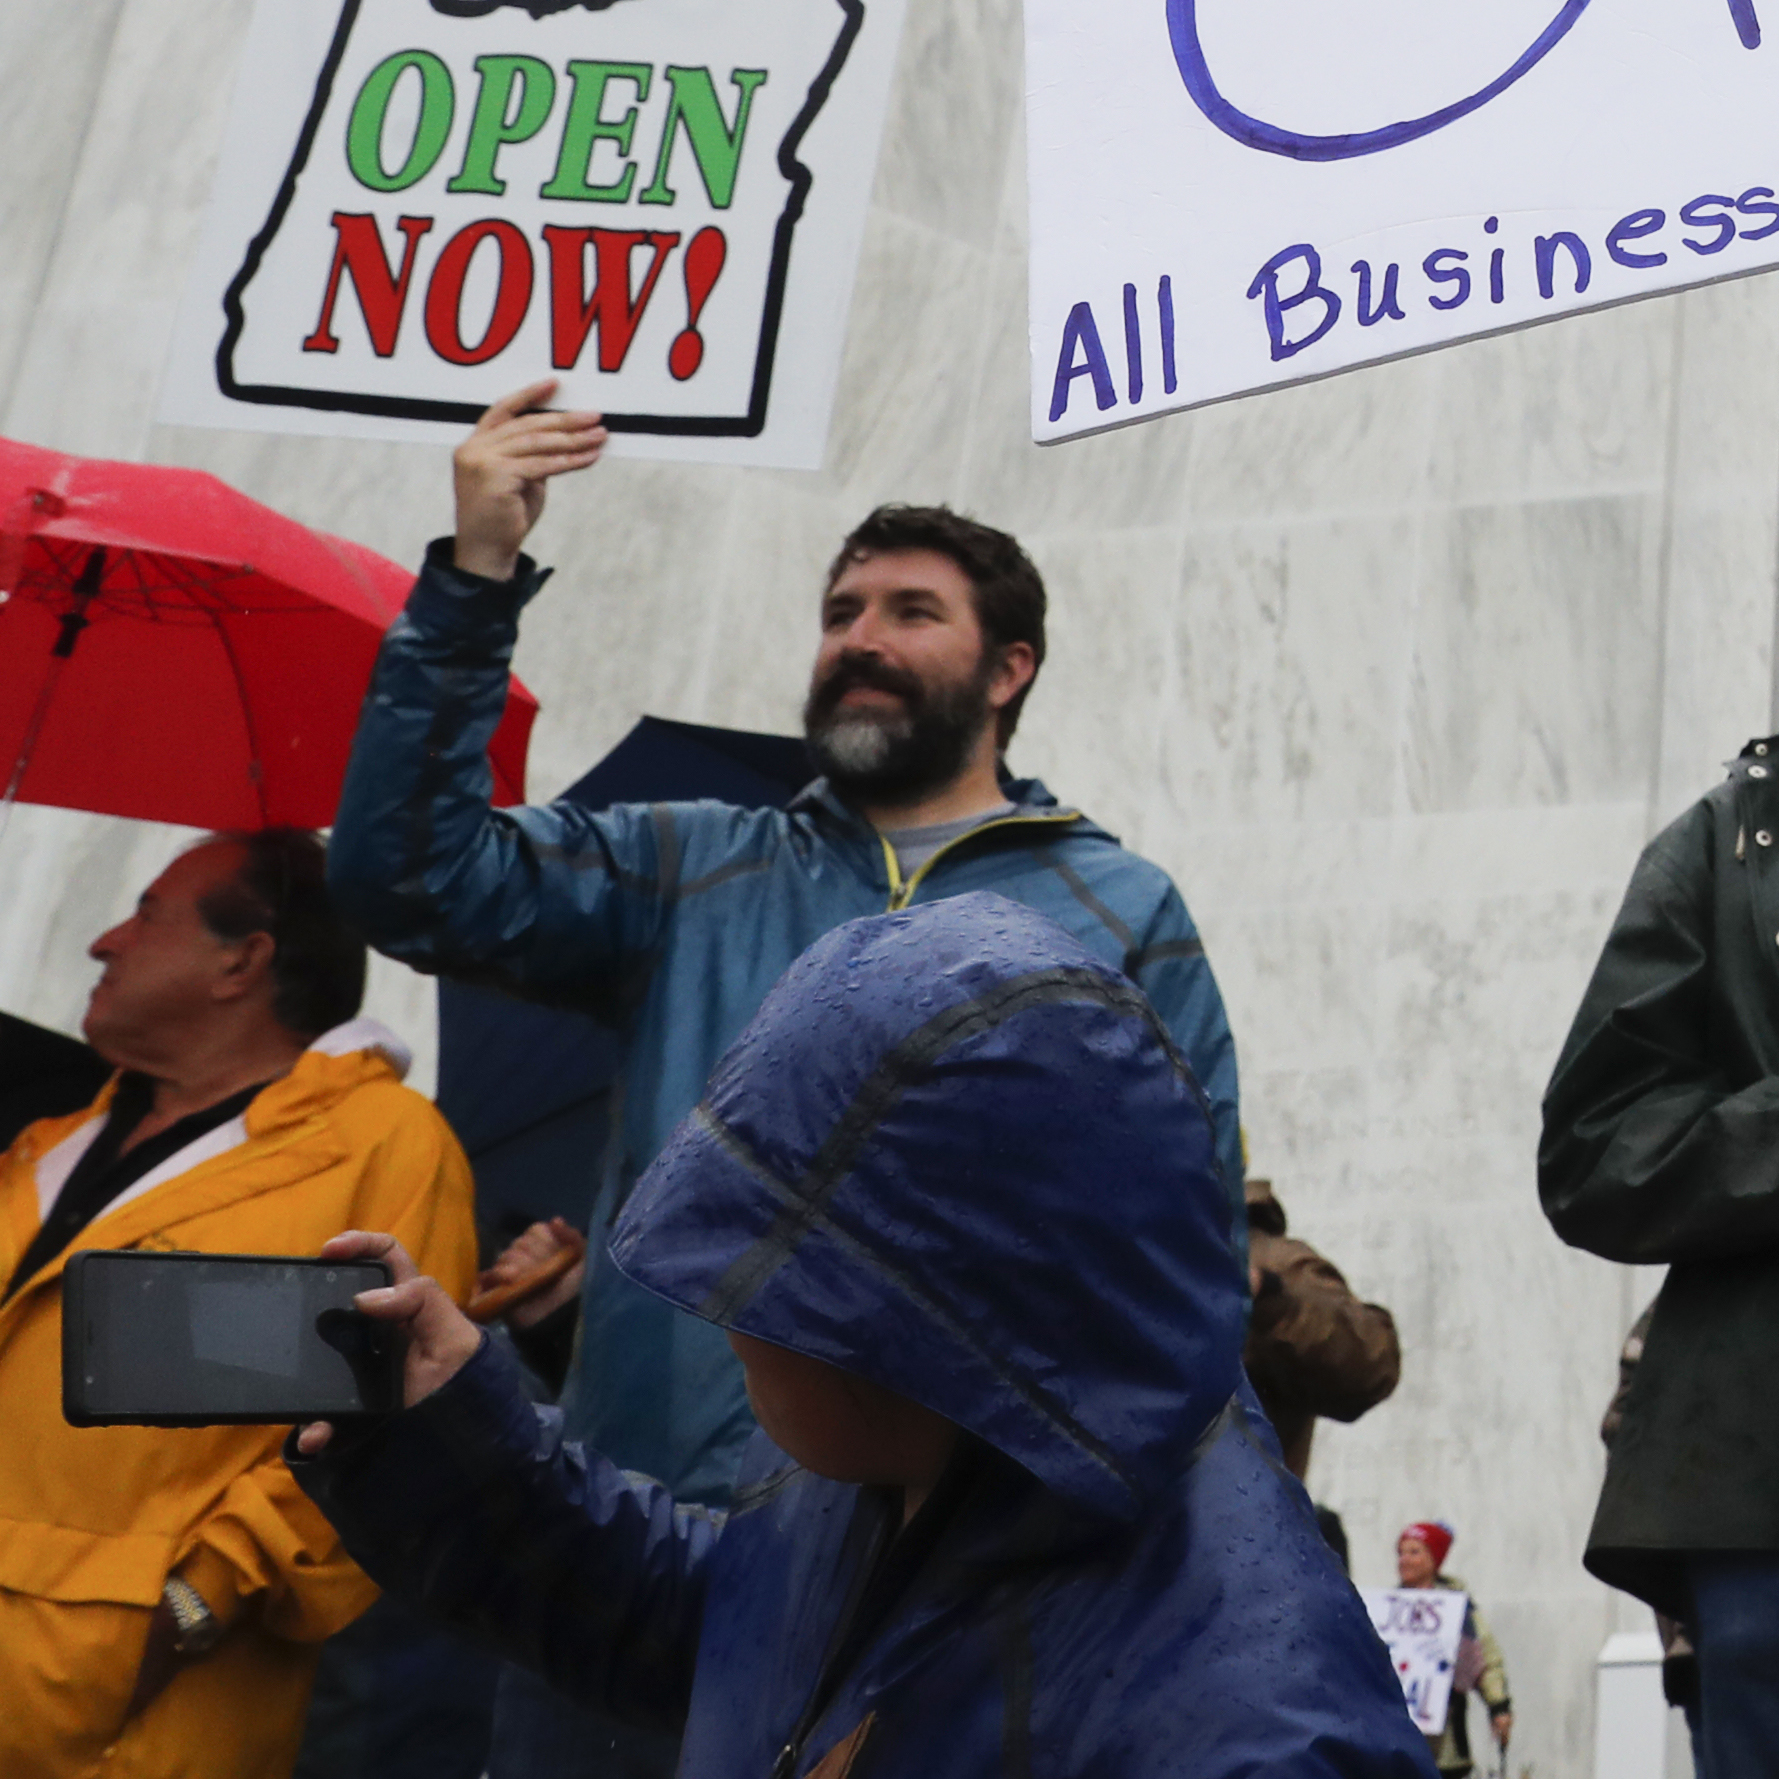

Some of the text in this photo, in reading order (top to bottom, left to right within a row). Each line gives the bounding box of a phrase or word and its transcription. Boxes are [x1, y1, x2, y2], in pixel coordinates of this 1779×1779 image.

[346, 50, 768, 209] OPEN
[302, 211, 727, 381] NOW!
[1047, 274, 1179, 423] All
